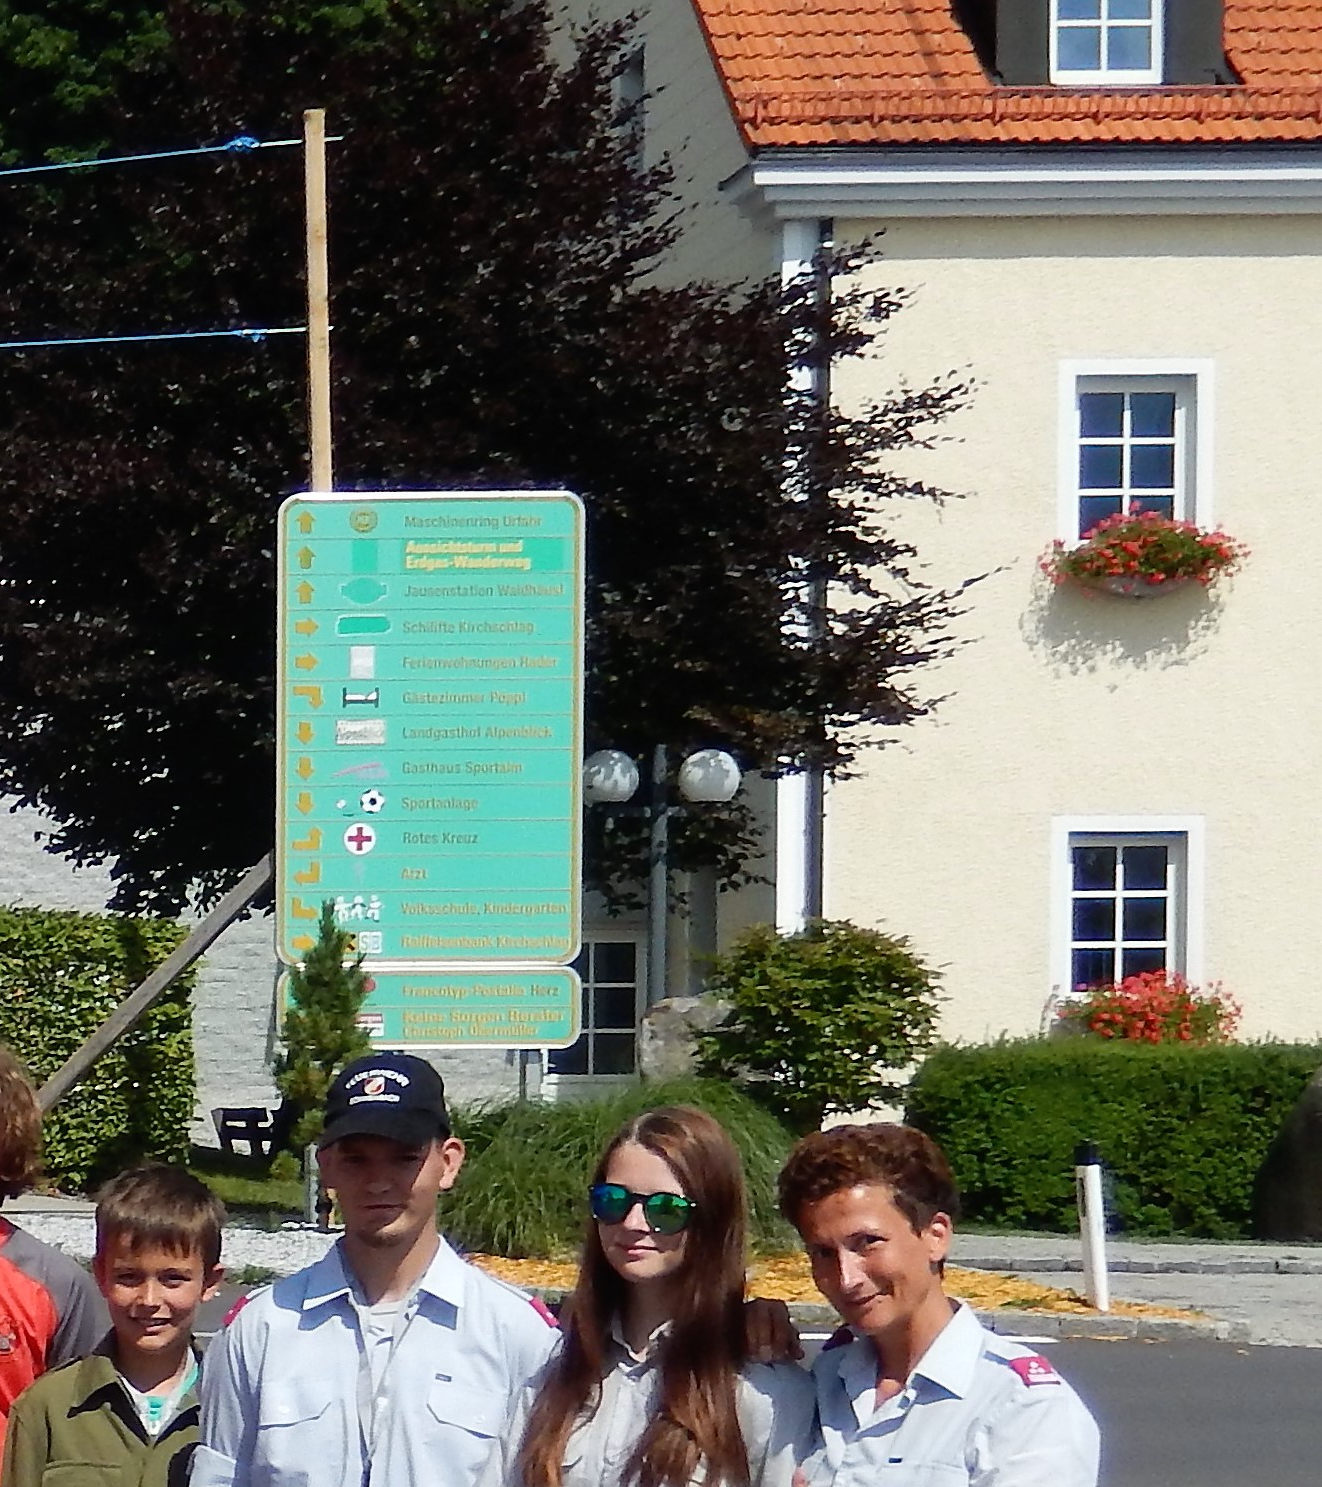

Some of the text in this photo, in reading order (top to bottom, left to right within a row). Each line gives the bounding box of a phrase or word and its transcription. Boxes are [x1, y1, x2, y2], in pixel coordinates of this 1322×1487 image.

[402, 761, 461, 774] Gasthaus
[401, 797, 478, 811] Sportanlage
[403, 832, 478, 844] Rotes Kreuz
[401, 868, 427, 879] Arzt
